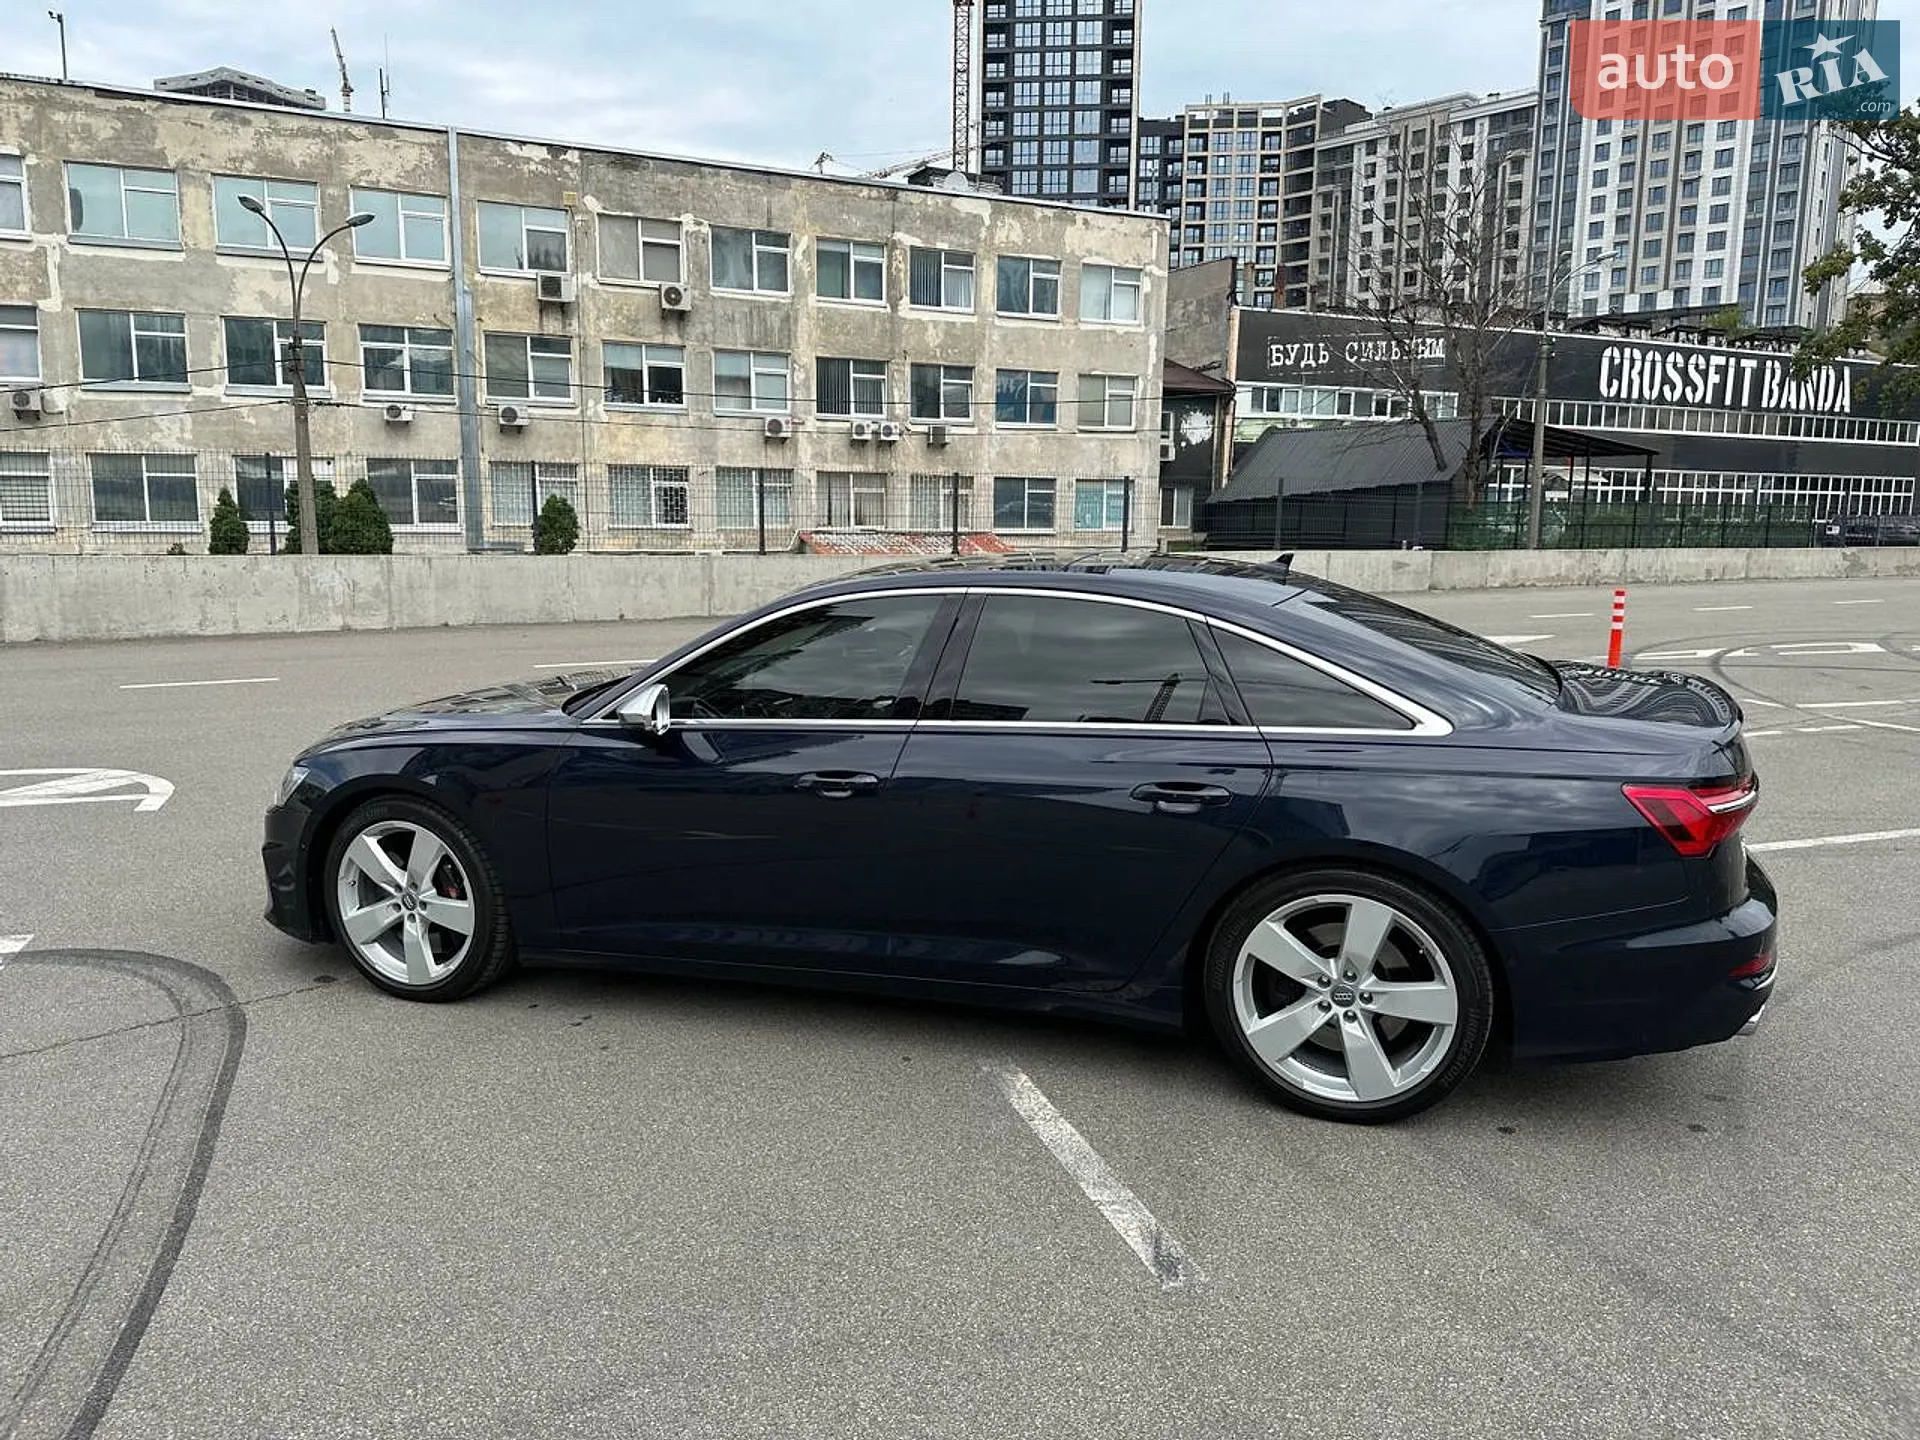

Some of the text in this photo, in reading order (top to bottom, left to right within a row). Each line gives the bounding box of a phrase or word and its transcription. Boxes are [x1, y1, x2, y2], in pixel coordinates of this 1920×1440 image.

[1270, 343, 1329, 368] БУДЬ
[1600, 346, 1851, 413] CROSSFIT BANDA
